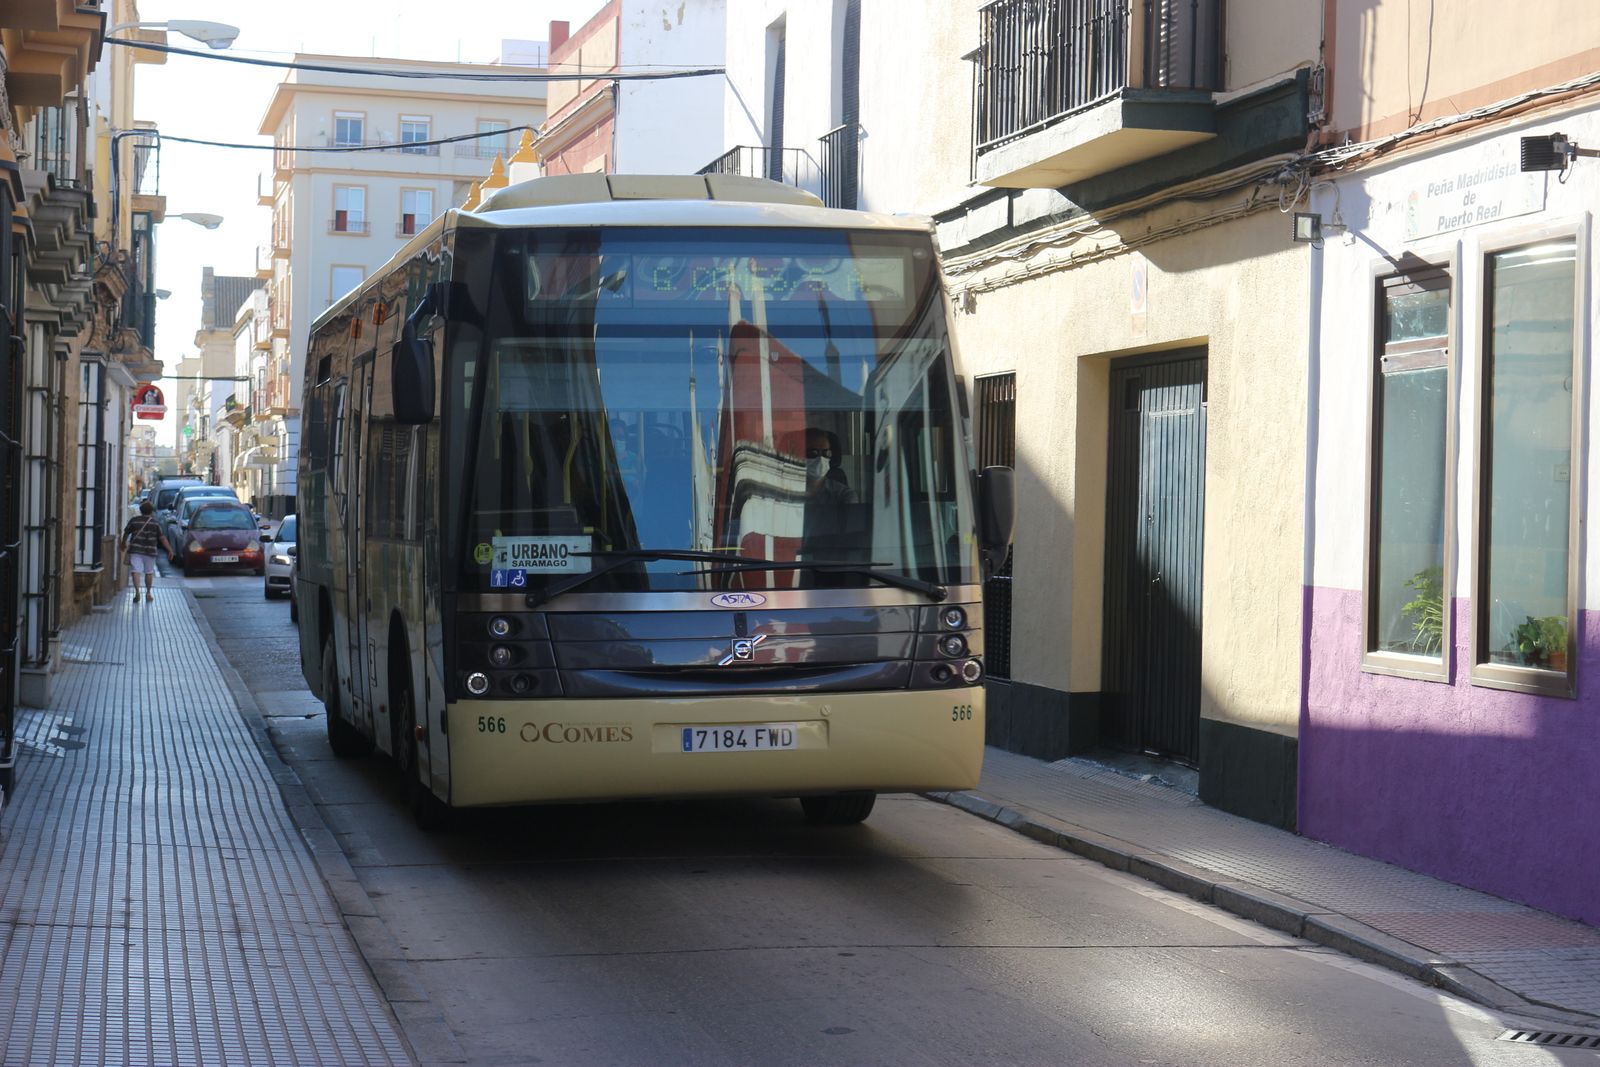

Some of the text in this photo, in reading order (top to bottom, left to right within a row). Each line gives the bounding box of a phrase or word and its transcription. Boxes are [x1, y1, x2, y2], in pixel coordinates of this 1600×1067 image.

[1427, 163, 1517, 198] Peña Madridista
[1463, 191, 1476, 206] de
[1437, 201, 1502, 231] Puerto Real
[511, 543, 568, 559] URBANO
[511, 559, 568, 568] SARAMAGO
[952, 705, 972, 722] 566
[478, 716, 506, 734] 566
[696, 728, 793, 749] 7184 FWD
